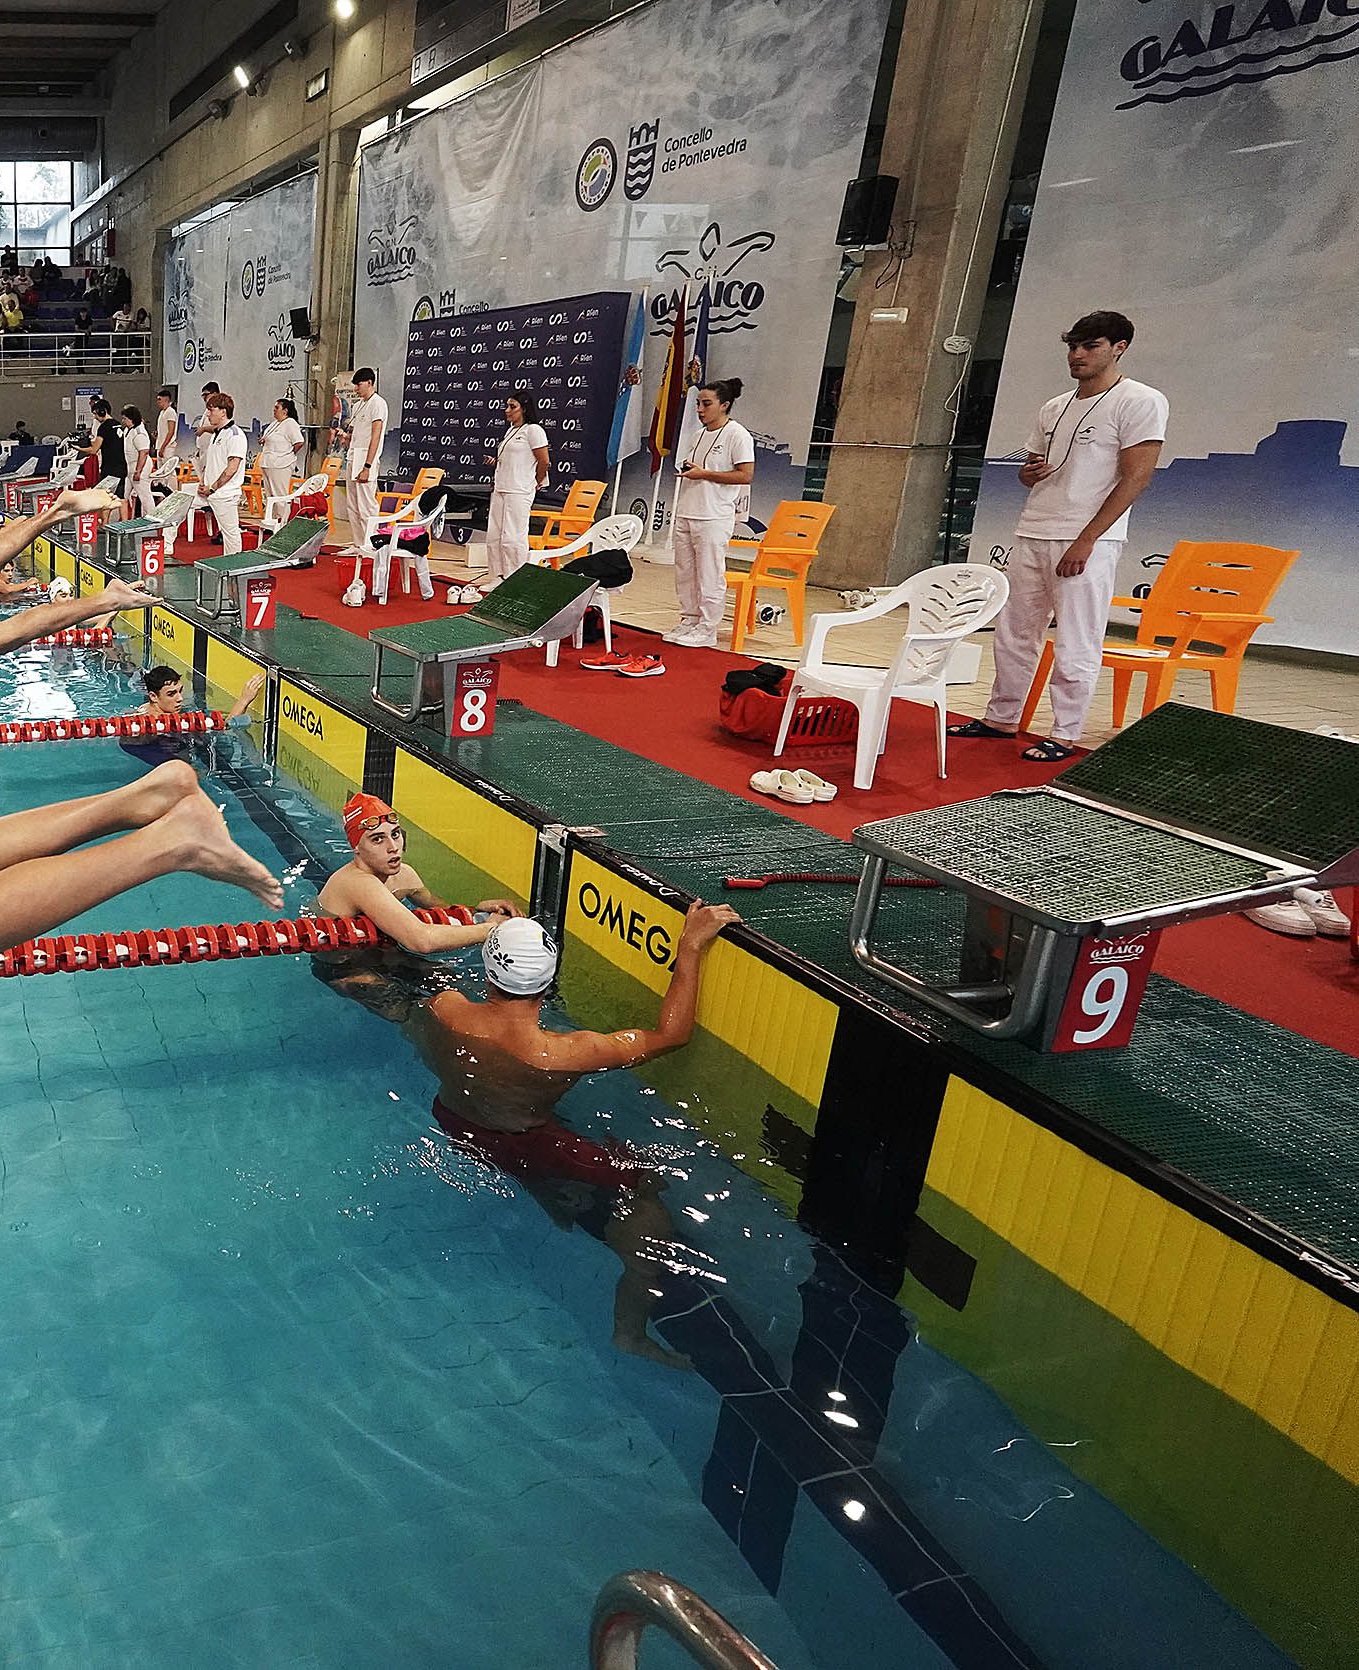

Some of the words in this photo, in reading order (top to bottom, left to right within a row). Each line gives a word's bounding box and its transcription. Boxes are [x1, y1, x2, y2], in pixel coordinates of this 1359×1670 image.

[664, 126, 713, 153] Concello
[661, 159, 676, 174] de
[678, 138, 748, 170] Pontevedra
[459, 301, 490, 314] Concello
[651, 279, 765, 320] GALAICO
[81, 522, 93, 542] 5
[145, 550, 159, 574] 6
[251, 596, 270, 626] 7
[153, 614, 175, 640] OMEGA
[282, 695, 324, 741] OMEGA
[460, 689, 487, 732] 8
[579, 882, 678, 973] OMEG
[1090, 944, 1145, 959] GALAICO
[1073, 966, 1129, 1044] 9
